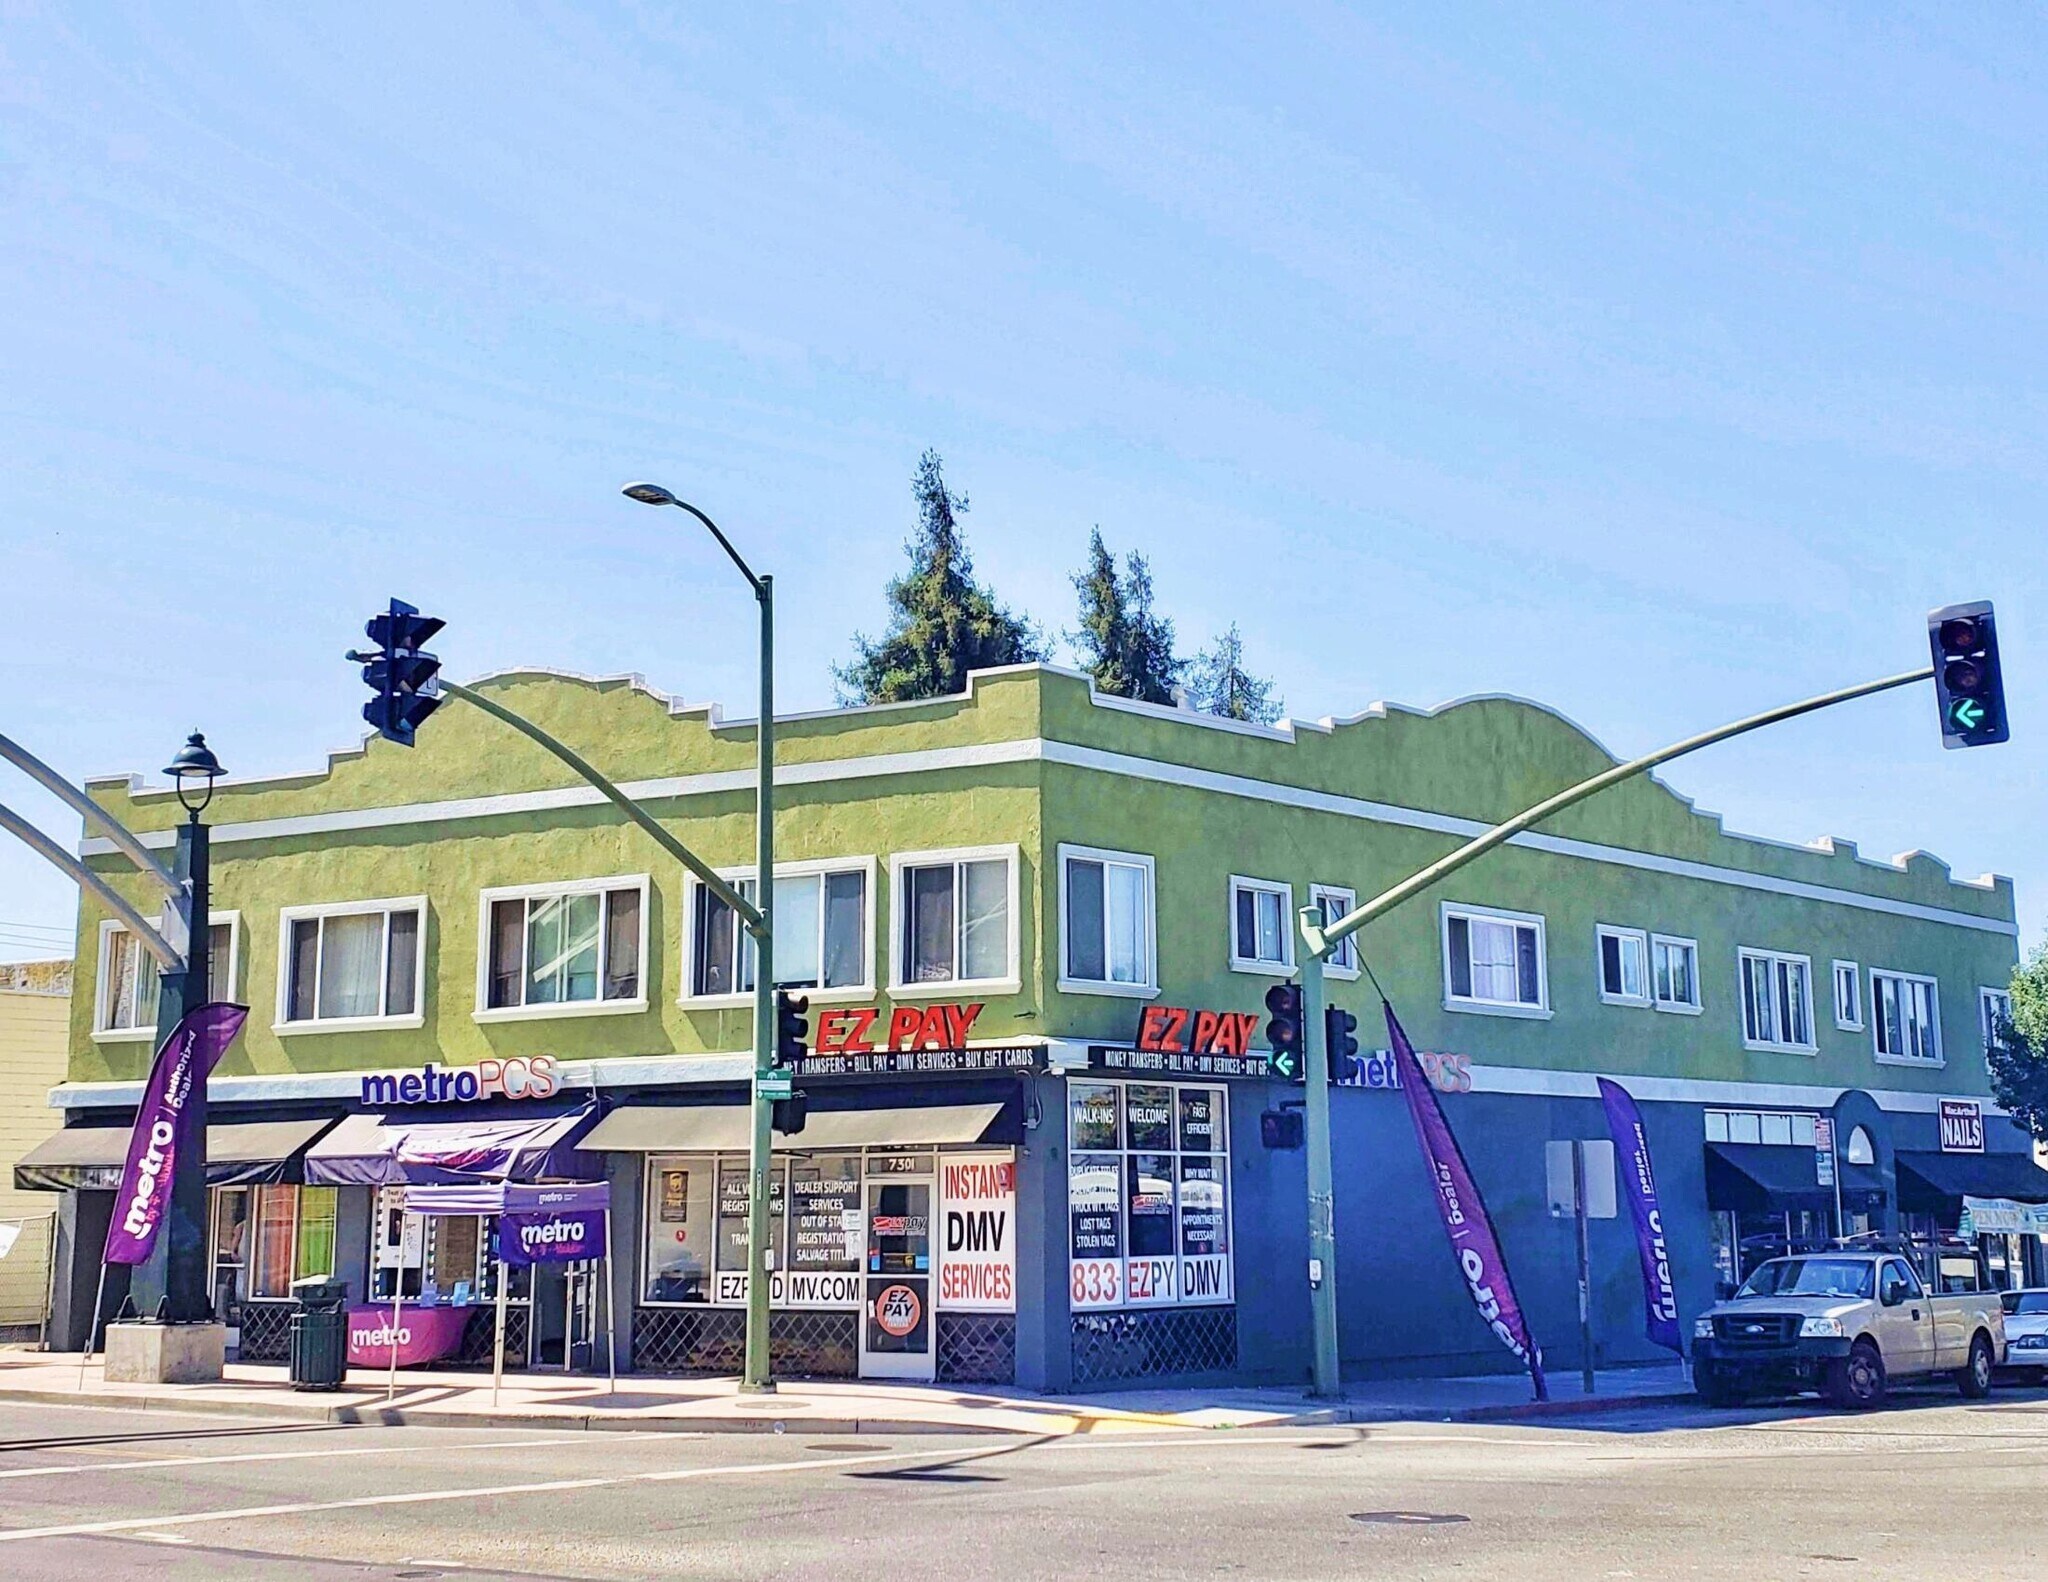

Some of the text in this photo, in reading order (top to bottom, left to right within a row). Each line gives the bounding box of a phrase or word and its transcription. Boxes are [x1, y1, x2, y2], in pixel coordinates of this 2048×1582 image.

[815, 1003, 984, 1054] EZ PAY
[1139, 1006, 1259, 1055] EZ PAY
[854, 1056, 871, 1072] BILL
[873, 1055, 887, 1071] PAY
[896, 1053, 914, 1070] DMV
[917, 1051, 956, 1069] SERVICES
[966, 1050, 981, 1067] BUY
[984, 1050, 1002, 1066] GIFT
[1005, 1049, 1033, 1066] CARDS
[1105, 1050, 1271, 1076] MONEY TRANSFERS BILL PAY DMV SERVICES BUY GIF
[362, 1056, 557, 1104] metroPCS
[172, 1068, 192, 1109] Deal
[1074, 1107, 1168, 1124] WALK-INS WELCOME
[1192, 1106, 1206, 1118] FAST
[1187, 1122, 1213, 1135] EFFICIENT
[1943, 1118, 1980, 1146] NAILS
[889, 1158, 915, 1171] 7301
[123, 1121, 173, 1240] metro
[794, 1181, 822, 1194] DEALER
[824, 1181, 858, 1194] SUPPORT
[945, 1164, 1008, 1199] INSTAN
[727, 1183, 741, 1195] ALL
[539, 1192, 563, 1205] metro
[808, 1198, 844, 1211] SERVICES
[801, 1215, 817, 1228] OUT
[817, 1215, 828, 1228] OF
[828, 1215, 844, 1228] STA
[1080, 1217, 1111, 1231] LOST TAGS
[1183, 1213, 1223, 1226] APPOINTMENTS
[521, 1219, 584, 1253] metro
[947, 1210, 1006, 1252] DMV
[1187, 1229, 1216, 1242] NECESSARY
[1076, 1234, 1115, 1248] STOLEN TAGS
[796, 1249, 828, 1261] SALVAGE
[943, 1262, 1011, 1300] SERVICES
[1129, 1260, 1174, 1298] EZPY
[1184, 1259, 1222, 1297] DMV
[888, 1290, 911, 1303] EZ
[883, 1303, 914, 1317] PAY
